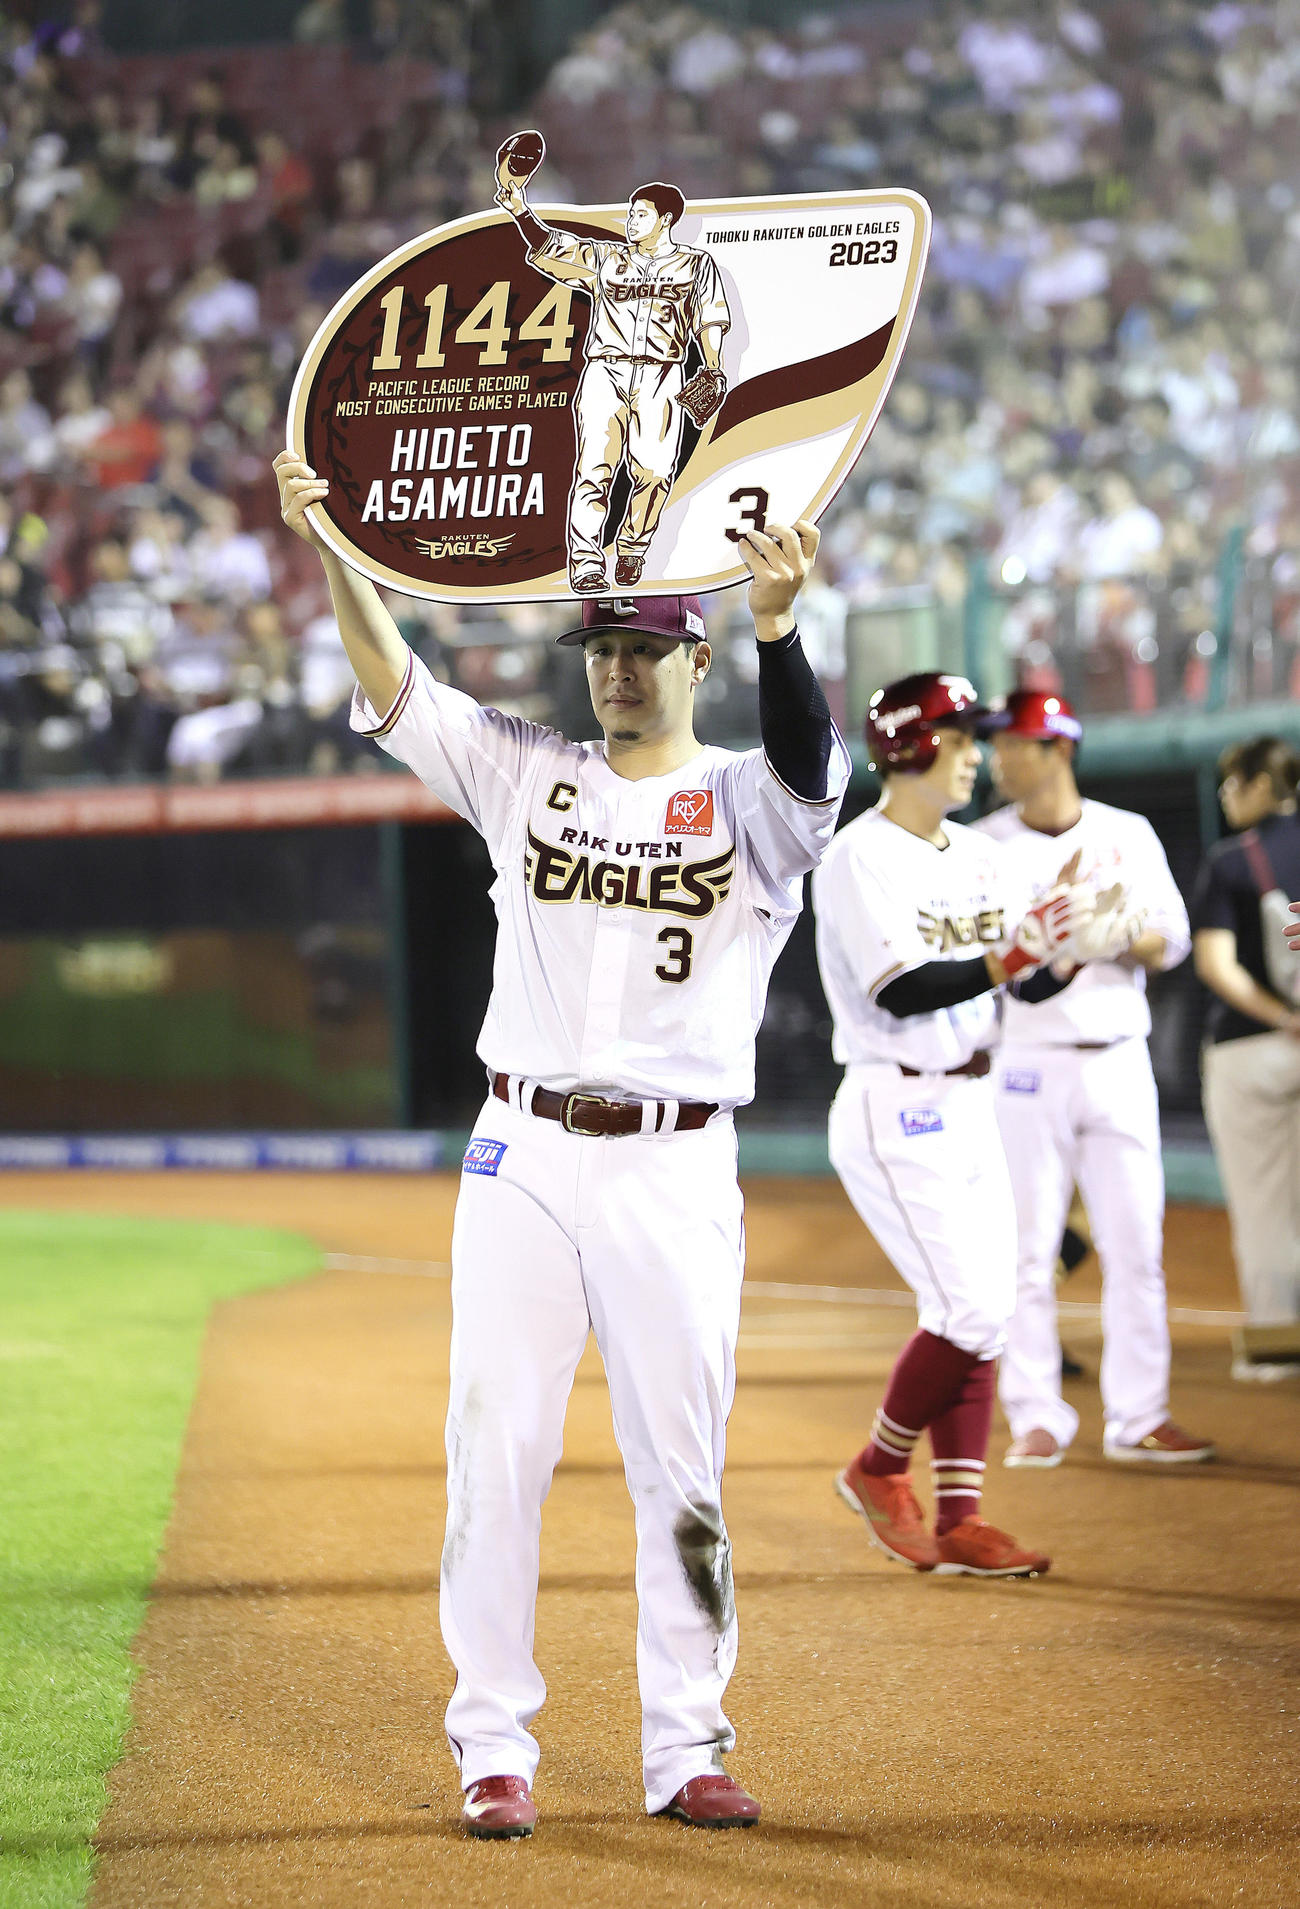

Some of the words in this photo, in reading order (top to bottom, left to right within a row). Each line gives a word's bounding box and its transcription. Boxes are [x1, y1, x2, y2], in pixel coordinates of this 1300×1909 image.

[706, 231, 749, 244] TOHOKU
[753, 227, 804, 241] RAKUTEN
[808, 224, 852, 238] GOLDEN
[856, 221, 900, 235] EAGLES
[829, 239, 898, 267] 2023
[608, 281, 690, 303] EAGLES
[372, 281, 575, 370] 1144
[658, 305, 673, 323] 3
[368, 381, 417, 397] PACIFIC
[422, 378, 473, 394] LEAGUE
[477, 375, 530, 392] RECORD
[336, 401, 371, 416] MOST
[375, 397, 464, 415] CONSECUTIVE
[468, 395, 512, 411] GAMES
[517, 392, 568, 408] PLAYED
[390, 423, 533, 472] HIDETO
[360, 472, 544, 523] ASAMURA
[725, 487, 769, 543] 3
[421, 537, 509, 560] EAGLES
[441, 533, 490, 541] RAKUTEN
[546, 780, 578, 812] C
[559, 827, 682, 859] RAKUTEN
[665, 824, 711, 835] アイリスオーヤマ
[527, 832, 736, 921] EAGLES
[655, 926, 694, 984] 3
